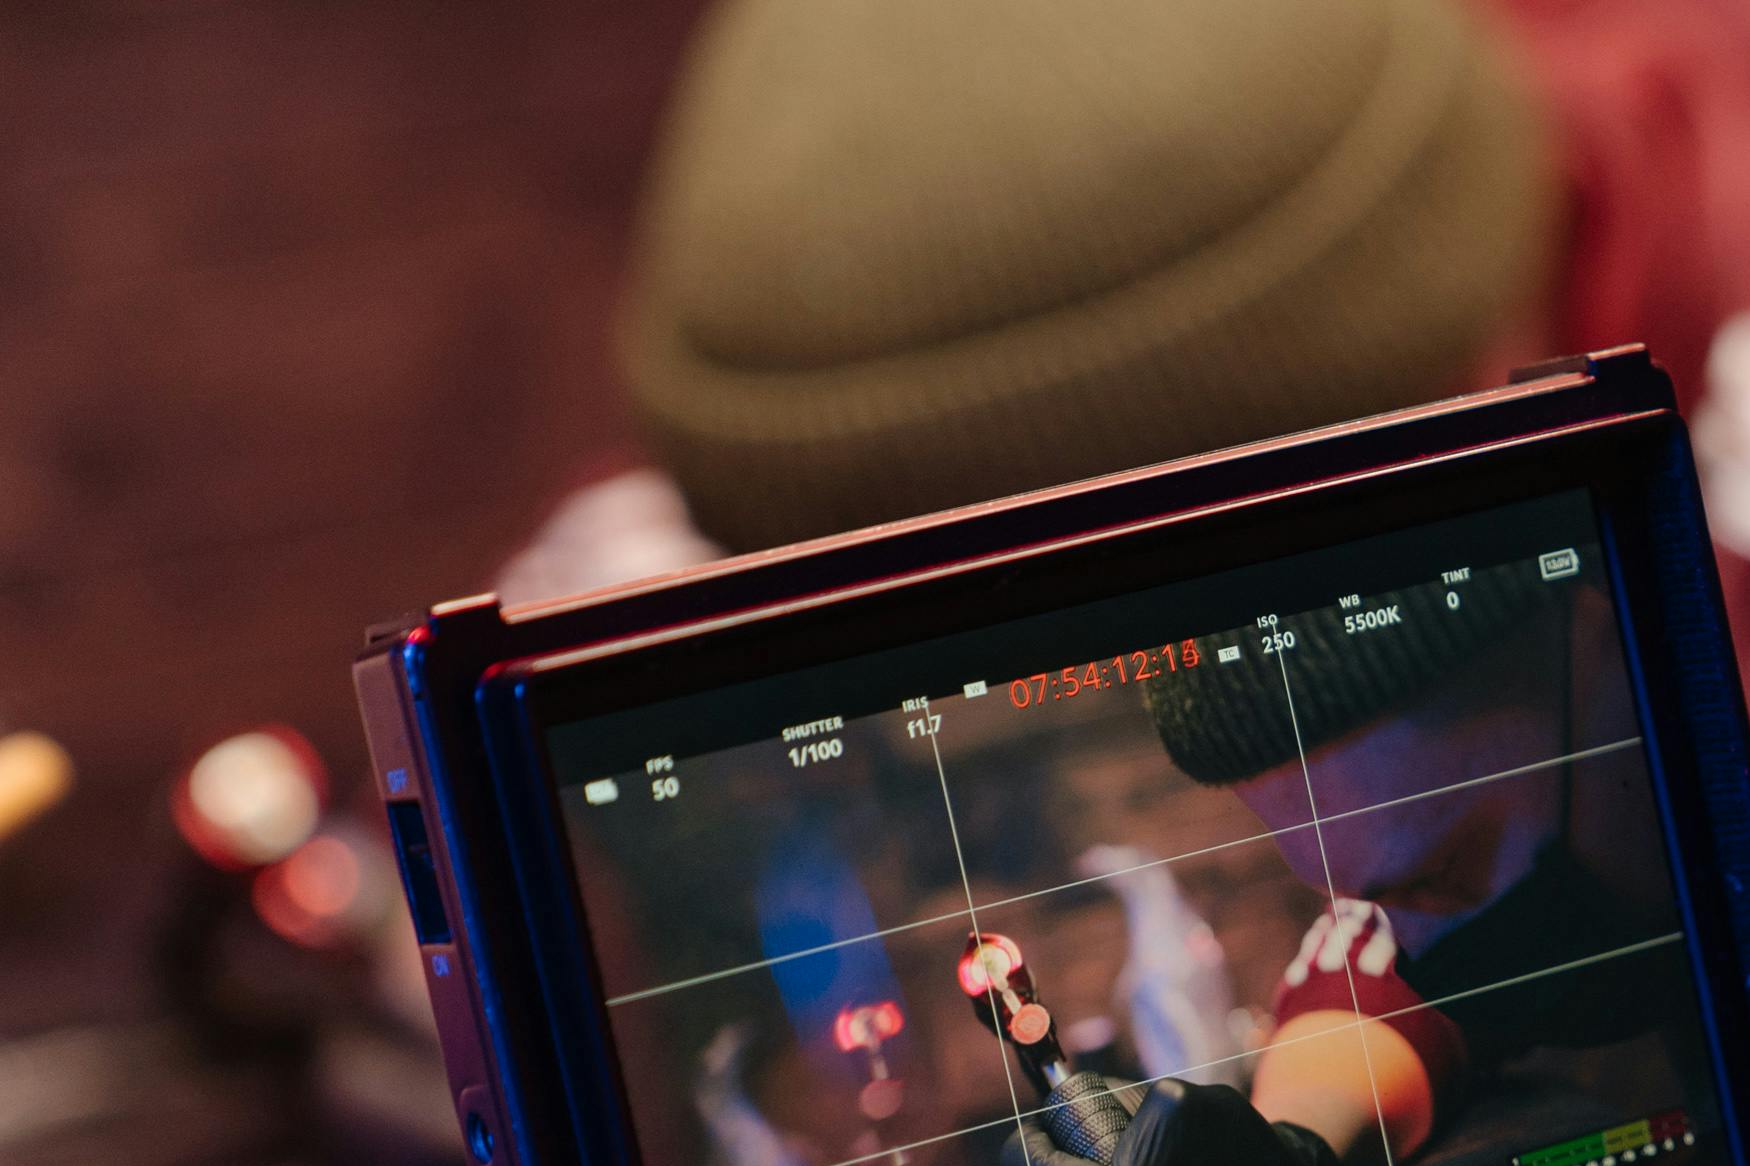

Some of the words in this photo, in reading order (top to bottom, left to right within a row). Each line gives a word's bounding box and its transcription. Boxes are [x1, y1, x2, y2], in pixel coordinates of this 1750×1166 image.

[1441, 566, 1470, 584] TINT
[1338, 594, 1361, 609] WB
[1446, 591, 1460, 610] 0
[1256, 613, 1278, 629] ISO
[1344, 604, 1401, 634] 5500K
[1261, 631, 1296, 654] 250
[902, 696, 929, 713] IRIS
[782, 716, 844, 742] SHUTTER
[907, 714, 942, 739] f1.7
[788, 738, 844, 768] 1/100
[646, 754, 674, 776] FPS
[652, 776, 679, 801] 50
